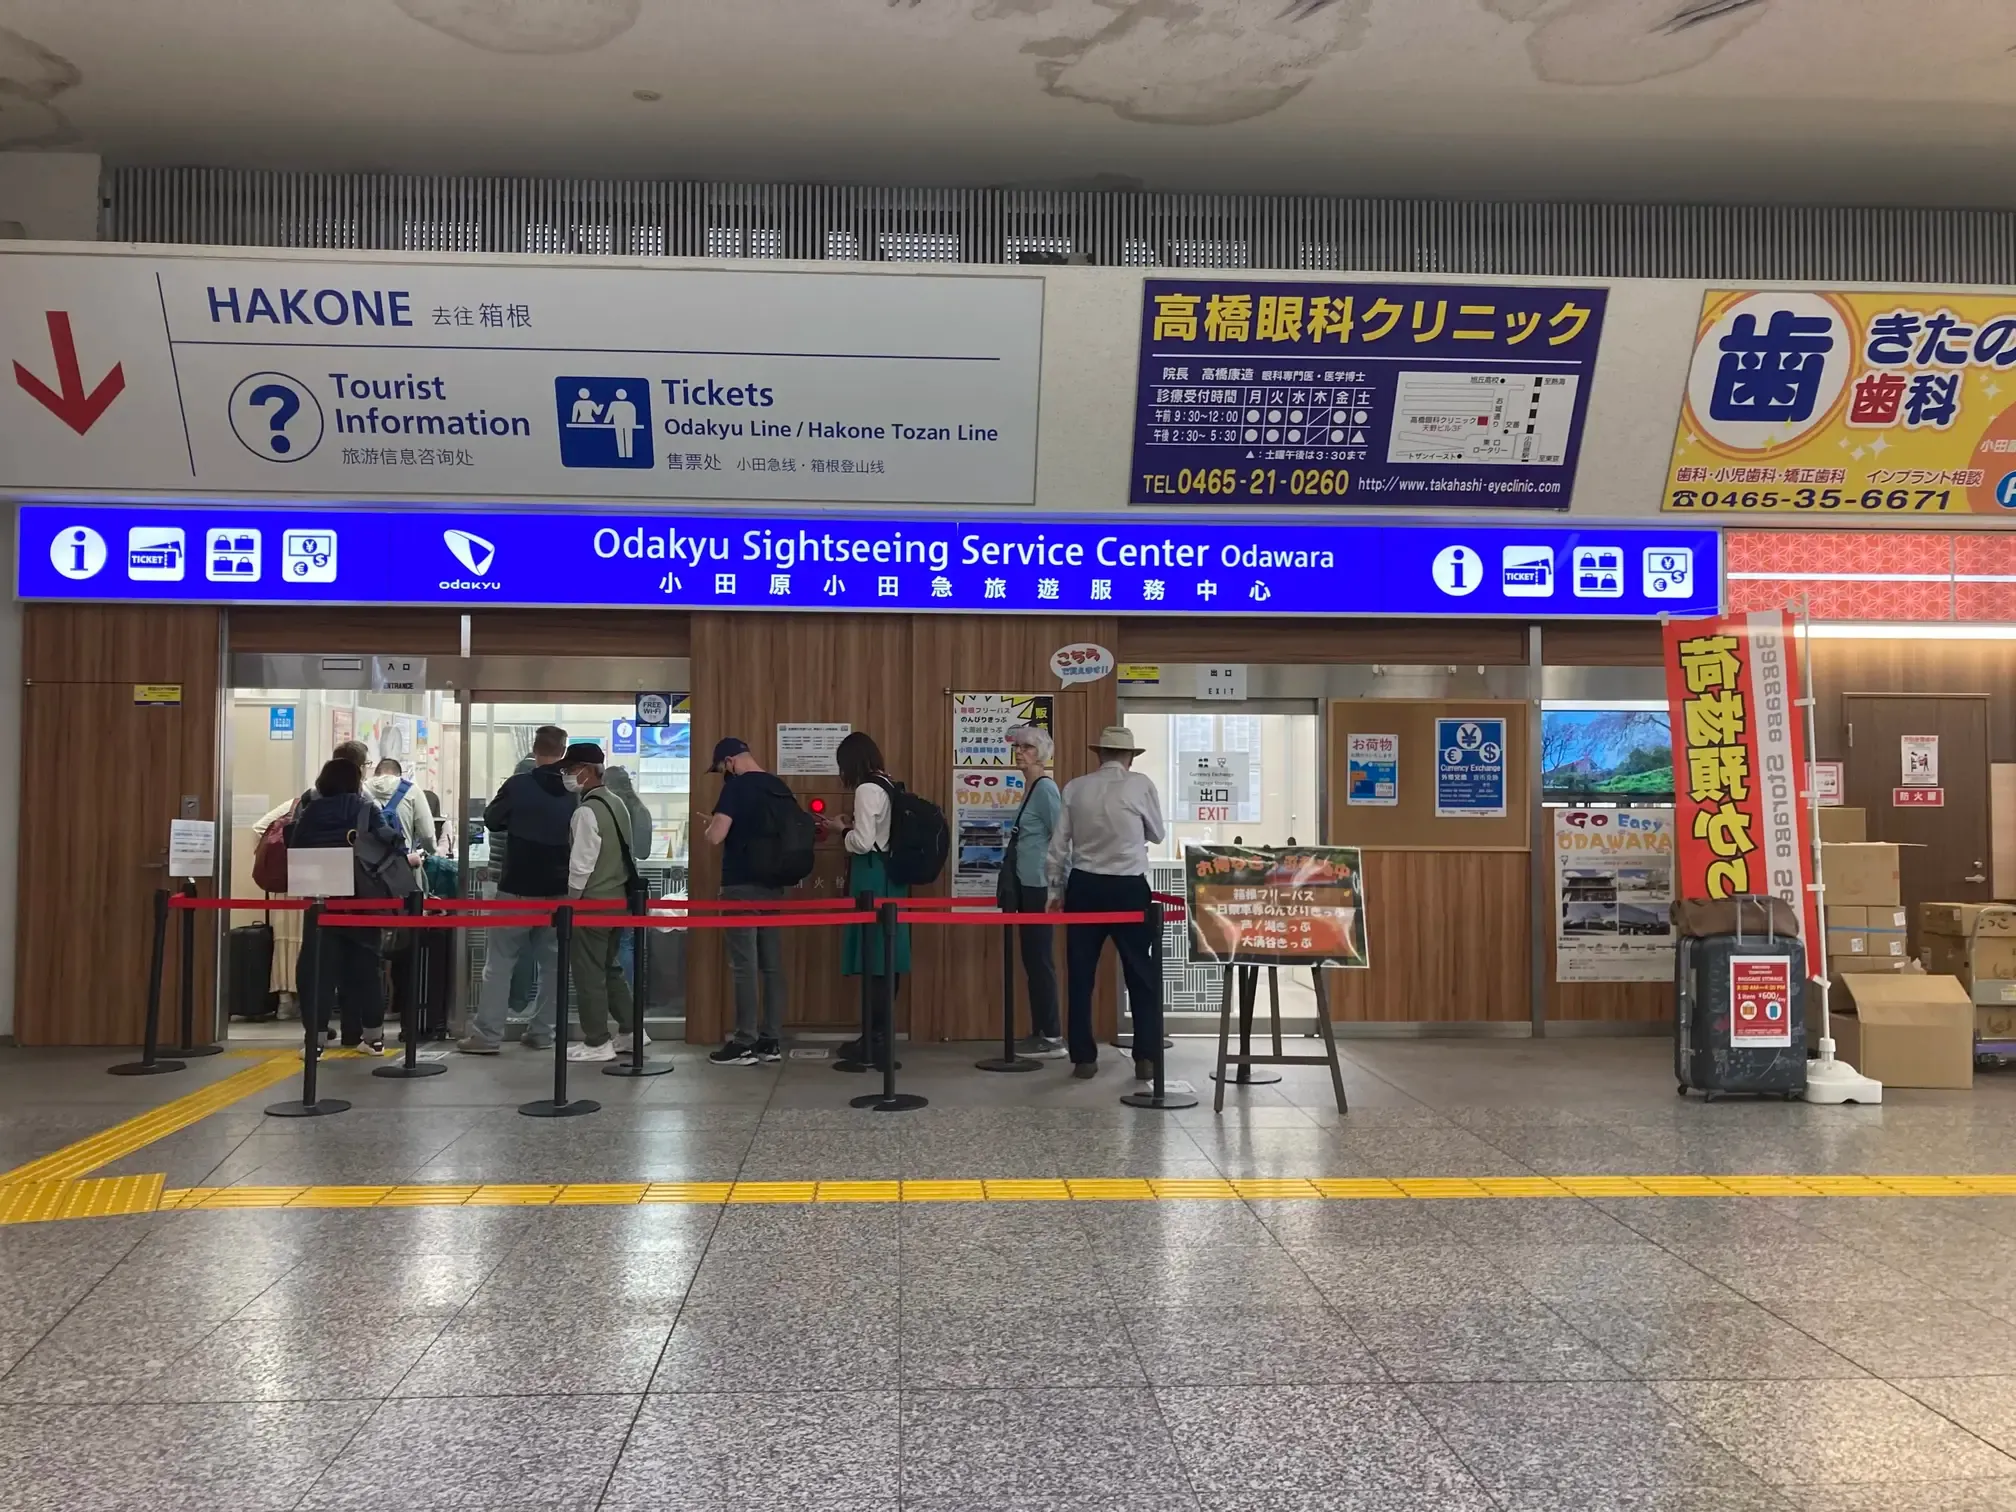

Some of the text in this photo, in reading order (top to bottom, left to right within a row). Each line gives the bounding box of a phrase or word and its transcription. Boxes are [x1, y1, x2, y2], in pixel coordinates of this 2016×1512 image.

[207, 286, 413, 327] HAKONE
[1153, 293, 1591, 346] 高橋眼科クリニック
[1867, 314, 2016, 366] きたの
[1162, 367, 1189, 381] 院長
[1202, 367, 1254, 381] 高橋康造
[1709, 310, 1834, 422] 歯
[329, 374, 446, 400] Tourist
[662, 379, 775, 408] Tickets
[1156, 389, 1370, 405] 診療受付時間 月 火 水 木 金 土
[1850, 373, 1959, 425] 歯科
[336, 407, 531, 437] Information
[664, 419, 743, 440] Odakyu
[750, 420, 790, 439] Line
[808, 421, 885, 440] Hakone
[892, 423, 950, 441] Tozan
[958, 424, 999, 442] Line
[342, 447, 475, 468] 旅游信息咨询处
[667, 453, 722, 473] 售票处
[1143, 468, 1350, 495] TEL 0465-21-0260
[1358, 476, 1561, 494] http://www.takahashi-eyeclinic.com
[1676, 467, 1983, 486] 歯科・小児歯科・矯正歯科 インプラント相談
[1701, 488, 1951, 511] 0465-35-6671
[593, 527, 1334, 571] Odakyu Sightseeing Service Center Odawara
[131, 554, 163, 565] TICKET
[1505, 572, 1535, 581] TICKET
[1057, 648, 1100, 666] こちら
[387, 663, 410, 671] 入口
[1210, 669, 1232, 677] 出口
[1353, 738, 1393, 751] お荷物
[1440, 764, 1501, 773] Currency Exchange
[964, 775, 999, 788] GO
[1200, 788, 1229, 802] 出口
[1198, 807, 1229, 820] EXIT
[1565, 812, 1664, 833] GO Easy
[1558, 832, 1673, 850] ODAWARA
[1233, 888, 1315, 901] 箱根フリーパス
